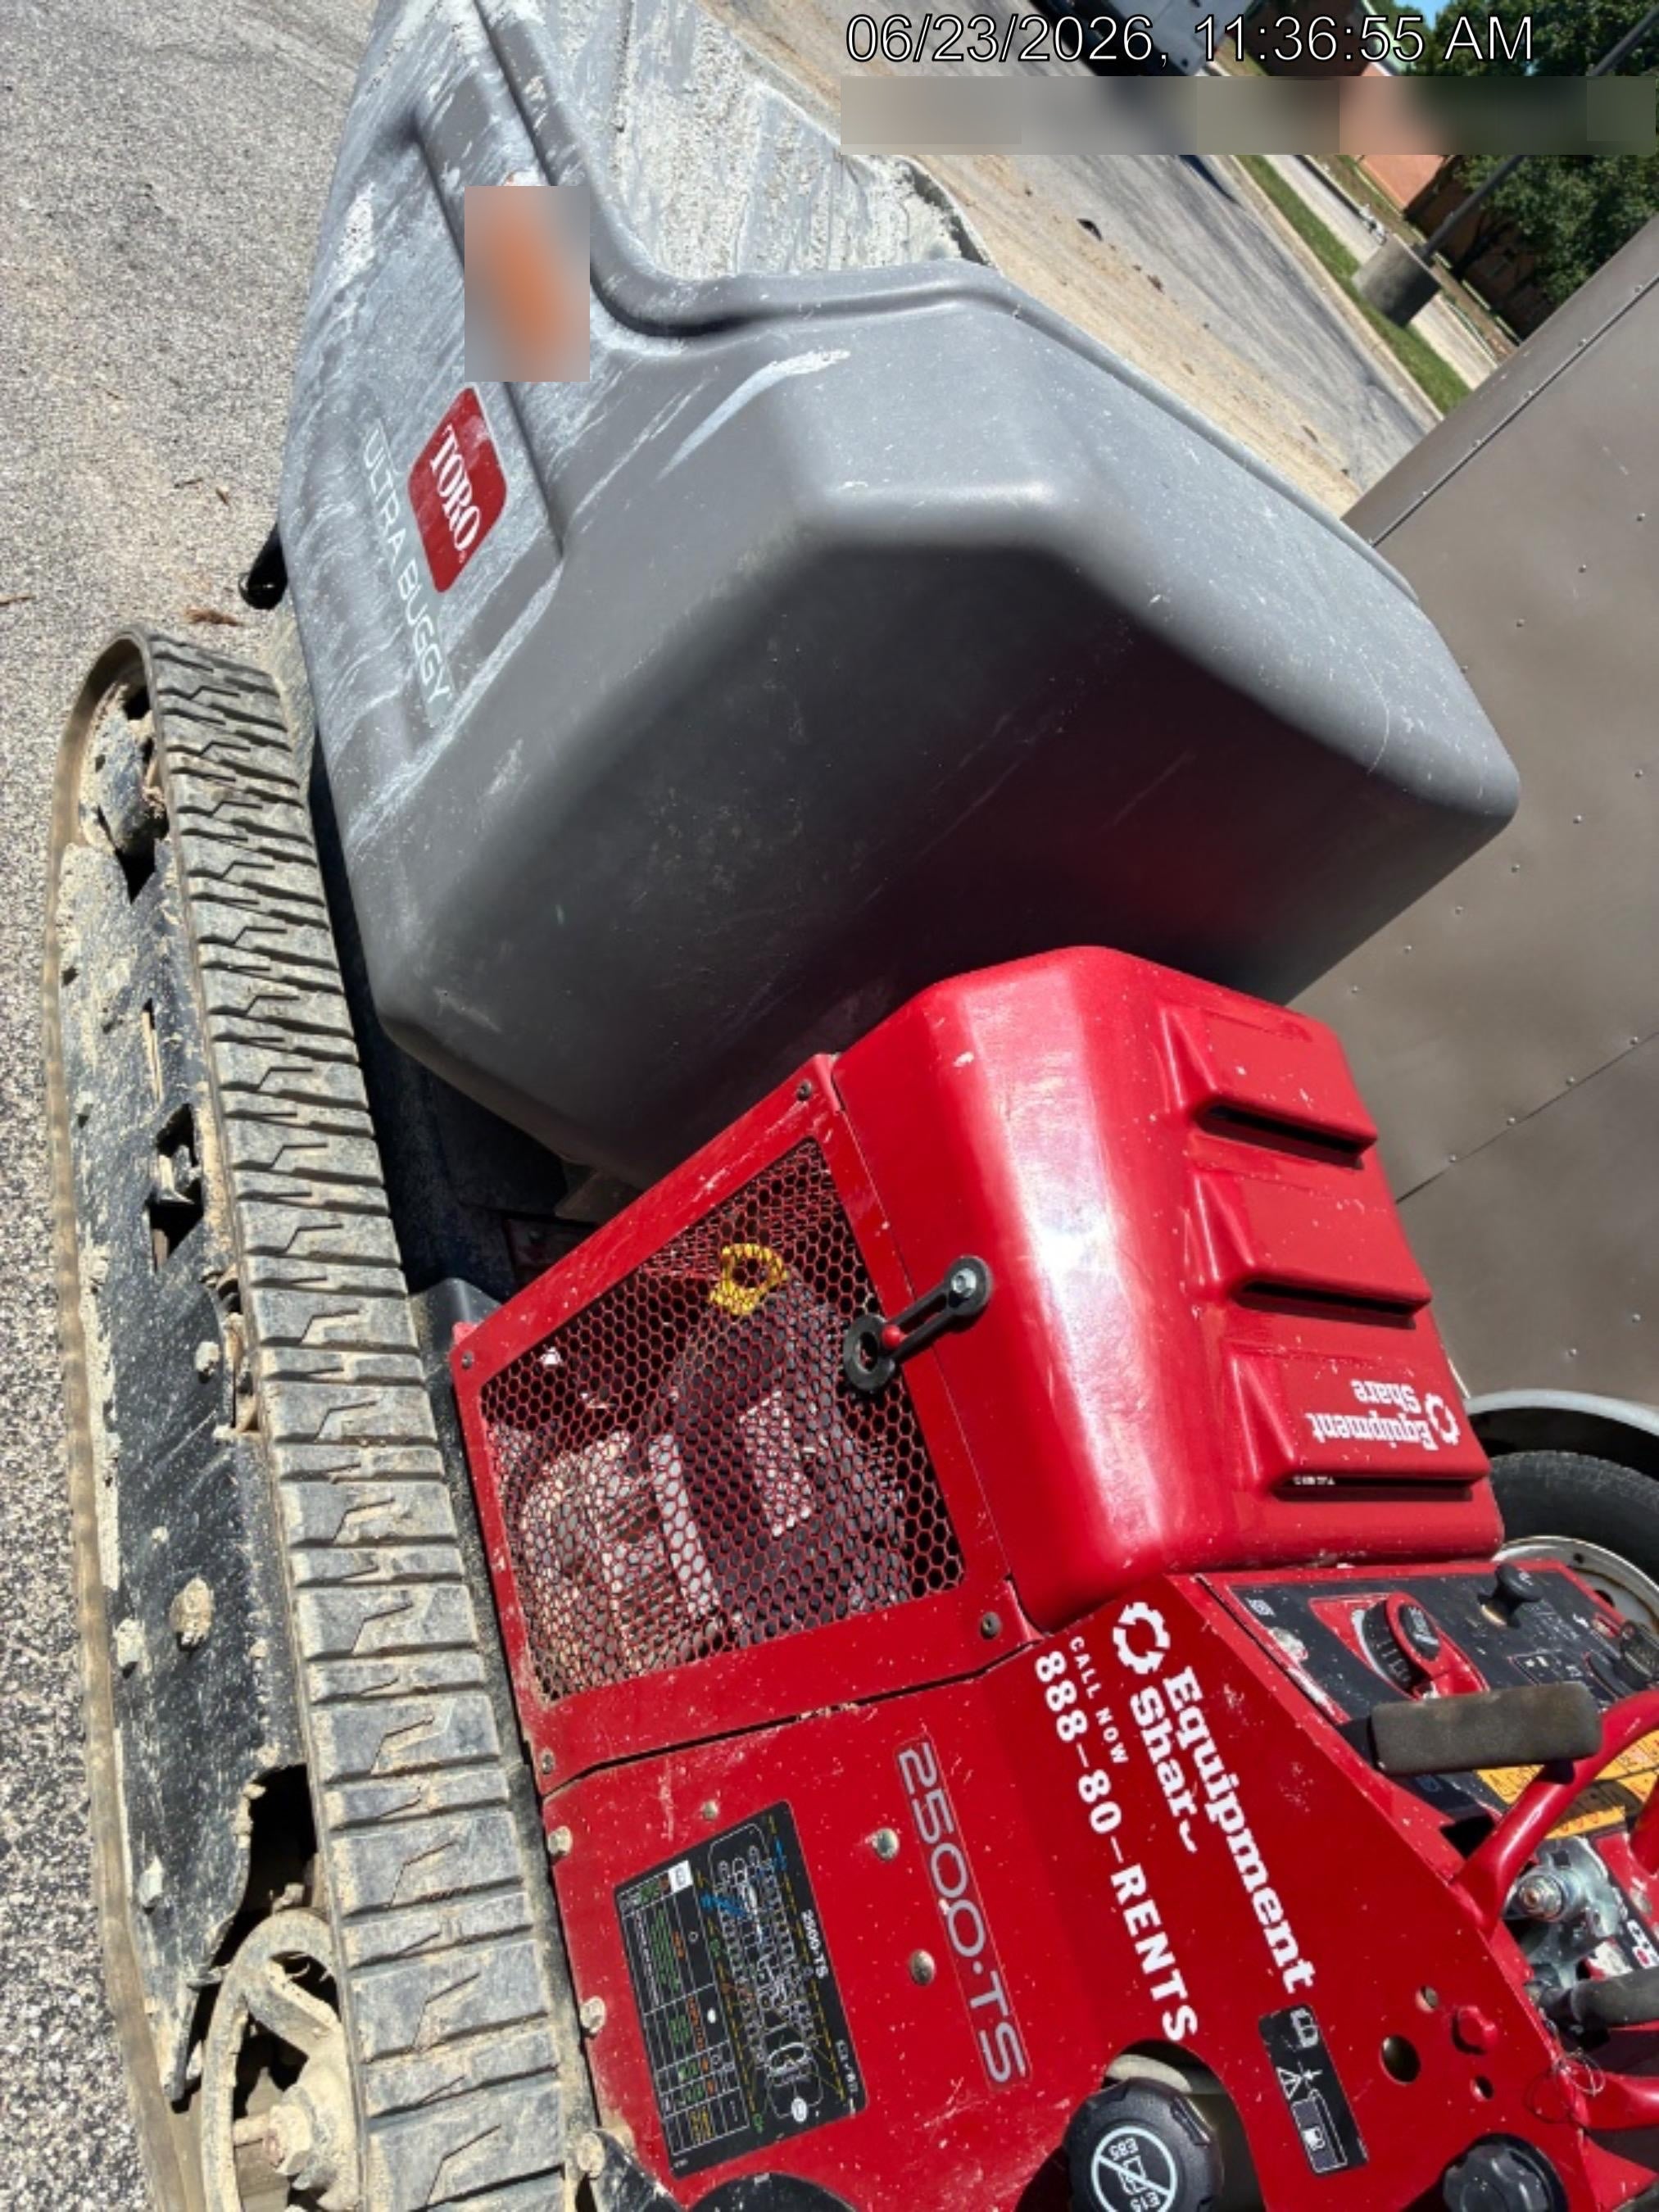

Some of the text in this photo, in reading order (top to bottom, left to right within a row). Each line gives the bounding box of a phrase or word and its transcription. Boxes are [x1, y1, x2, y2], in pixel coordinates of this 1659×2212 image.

[429, 424, 481, 551] TORO
[363, 428, 452, 703] ULTRA BUGGY
[1304, 1410, 1439, 1451] Equipment
[1350, 1379, 1422, 1415] Share
[1069, 1636, 1129, 1765] CALL NOW
[1035, 1650, 1199, 2042] 888-80-RENTS
[1163, 1665, 1316, 1994] Equipment
[1108, 2137, 1140, 2161] E85
